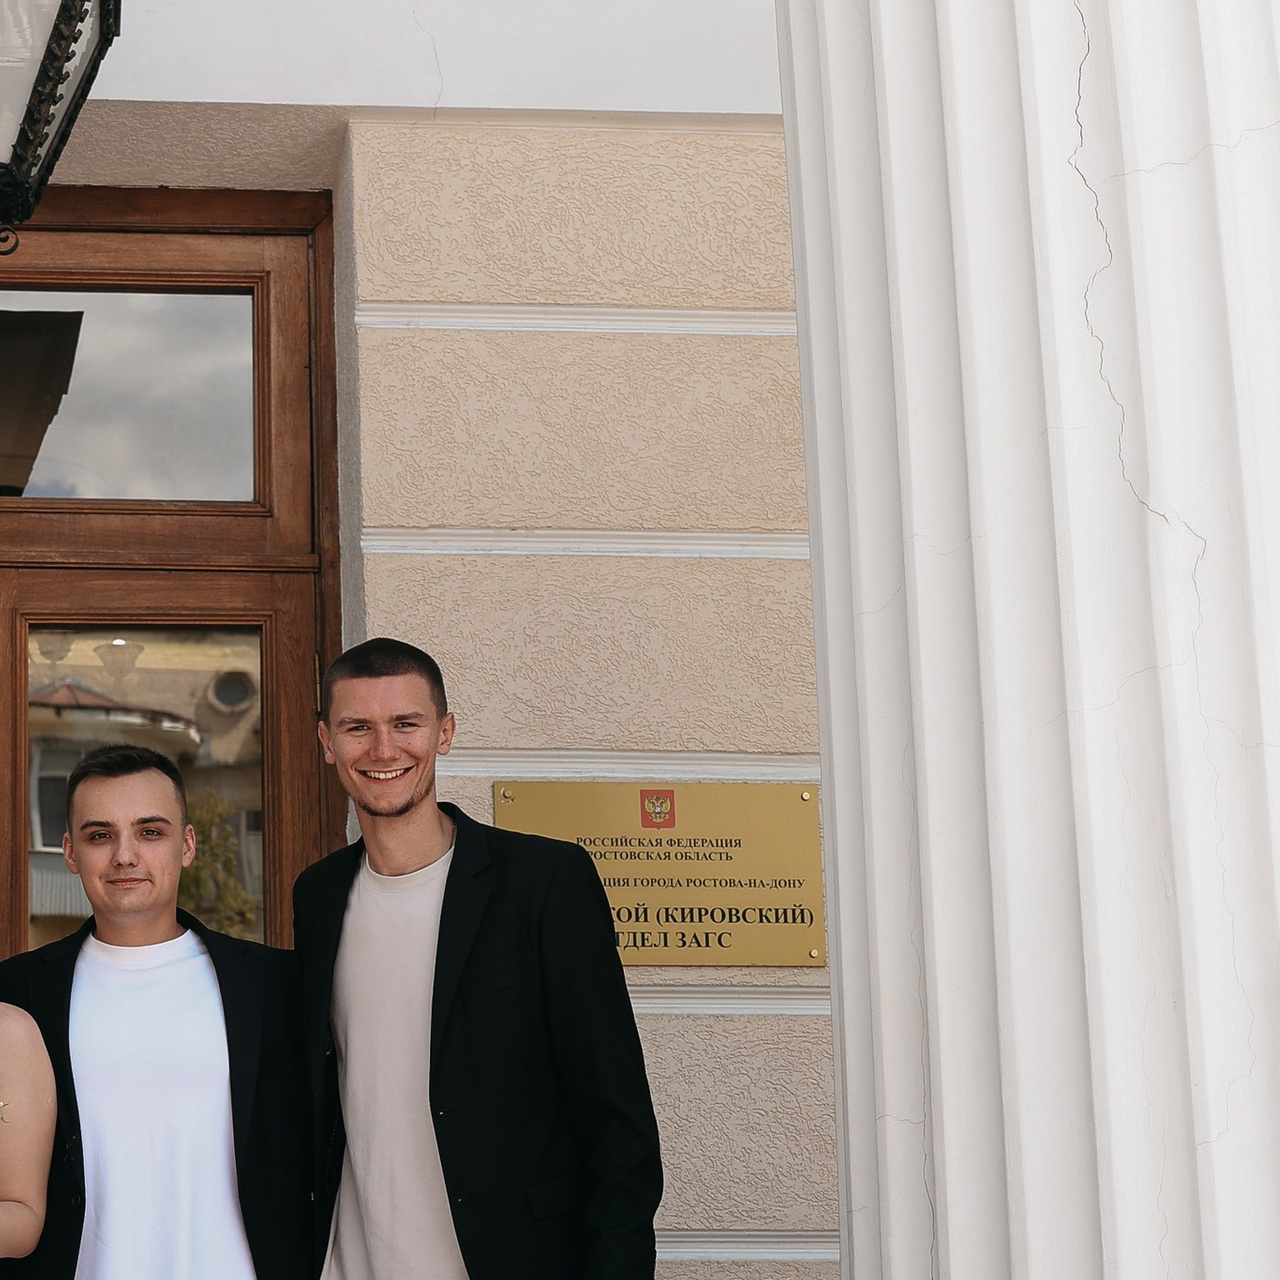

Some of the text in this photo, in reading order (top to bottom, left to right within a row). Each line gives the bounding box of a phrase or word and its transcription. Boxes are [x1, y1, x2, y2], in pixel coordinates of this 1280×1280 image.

[576, 835, 742, 849] РОССИЙСКАЯ ФЕДЕРАЦИЯ
[674, 851, 733, 861] ОБЛАСТЬ
[633, 877, 682, 889] ГОРОДА
[686, 878, 805, 889] РОСТОВА-НА-ДОНУ
[656, 903, 814, 928] (КИРОВСКИЙ)
[615, 931, 732, 951] ТДЕЛ ЗАГС
